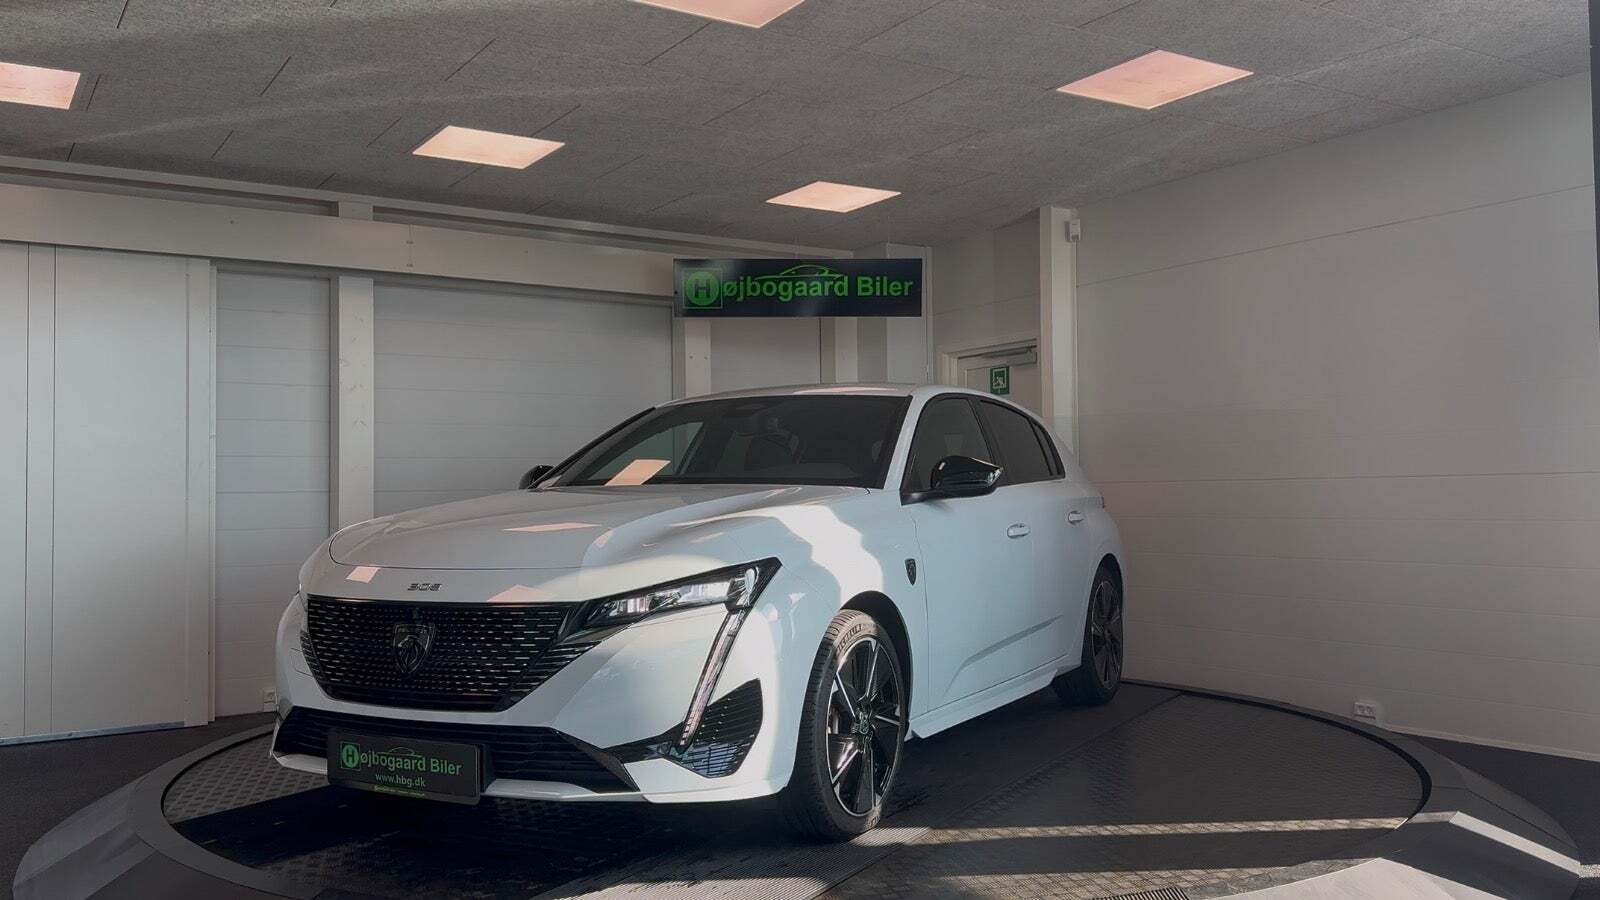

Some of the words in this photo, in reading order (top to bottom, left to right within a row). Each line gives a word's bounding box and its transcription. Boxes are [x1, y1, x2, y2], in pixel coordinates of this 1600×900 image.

[857, 276, 914, 297] Biler
[430, 758, 463, 775] Biler
[375, 773, 426, 788] www.hbg.dk
